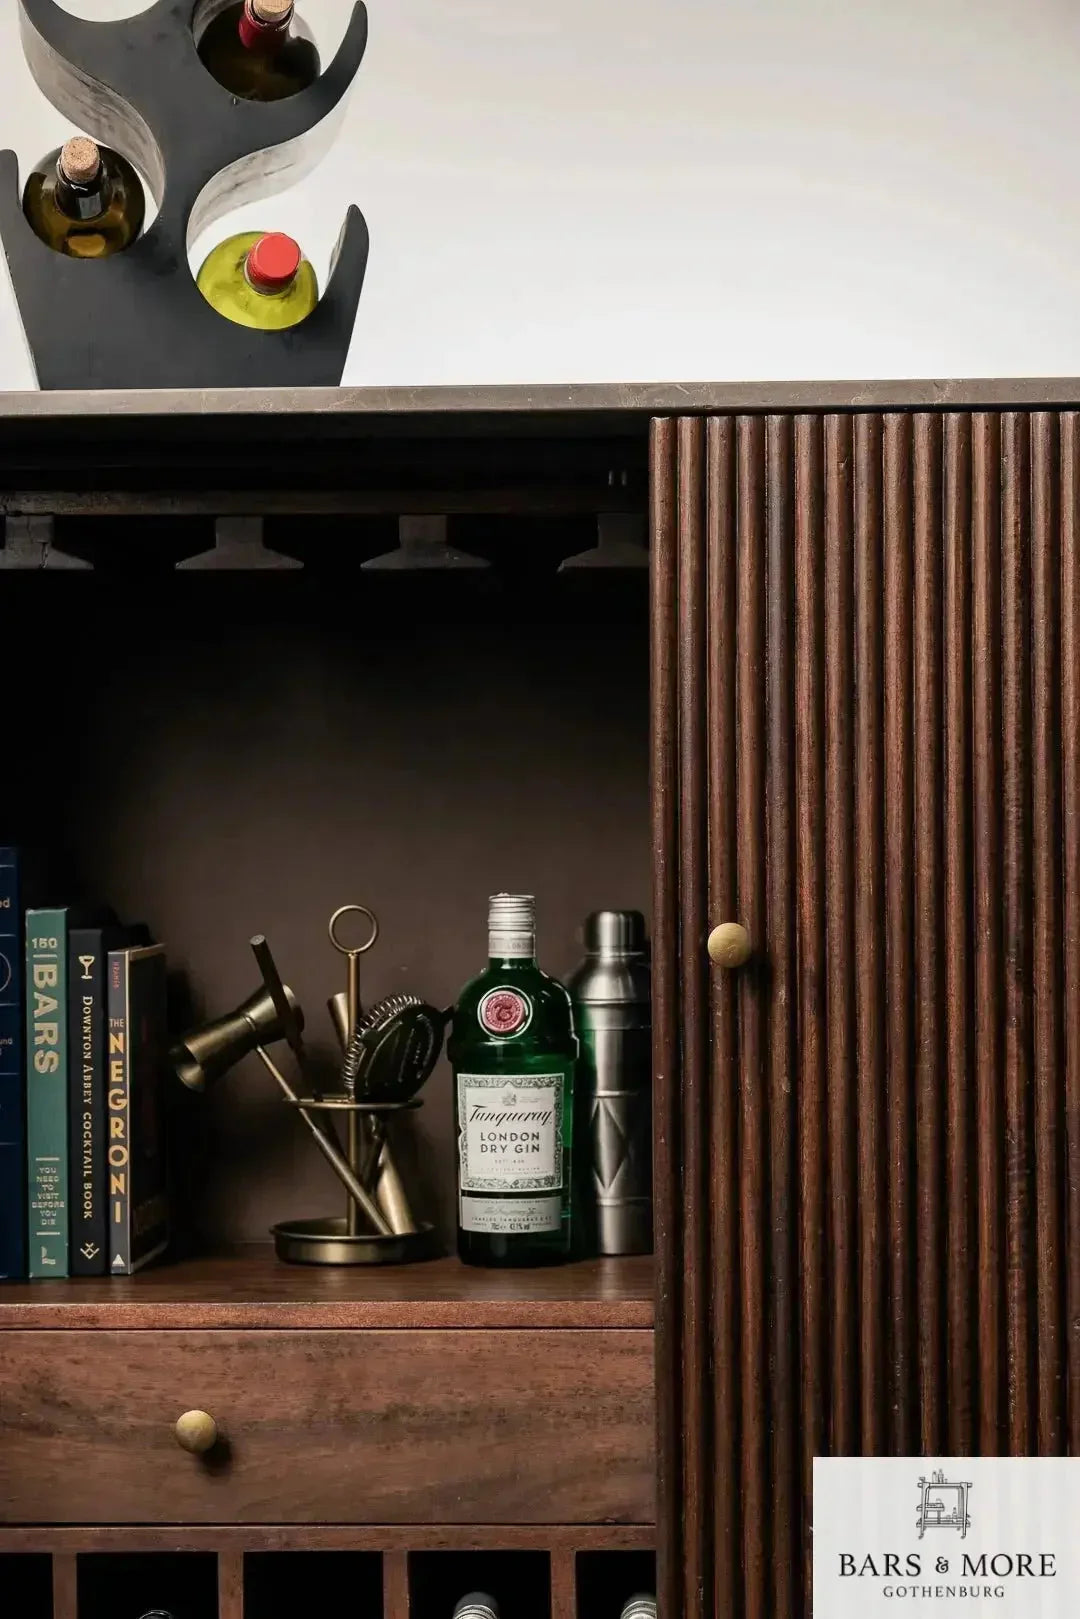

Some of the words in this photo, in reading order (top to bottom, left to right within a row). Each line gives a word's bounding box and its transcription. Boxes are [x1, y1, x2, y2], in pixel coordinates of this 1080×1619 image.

[32, 937, 58, 949] 150
[33, 964, 60, 1074] BARS
[82, 996, 93, 1060] DOWNTON
[109, 1018, 124, 1028] THE
[83, 1064, 93, 1104] ABBEY
[108, 1032, 129, 1223] NEGRONI
[469, 1104, 553, 1126] Tanqueray
[83, 1112, 92, 1177] COCKTAIL
[480, 1132, 540, 1142] LONDON
[480, 1144, 507, 1153] DRY
[514, 1144, 540, 1153] GIN
[84, 1183, 93, 1219] BOOK
[41, 1218, 56, 1226] DIE
